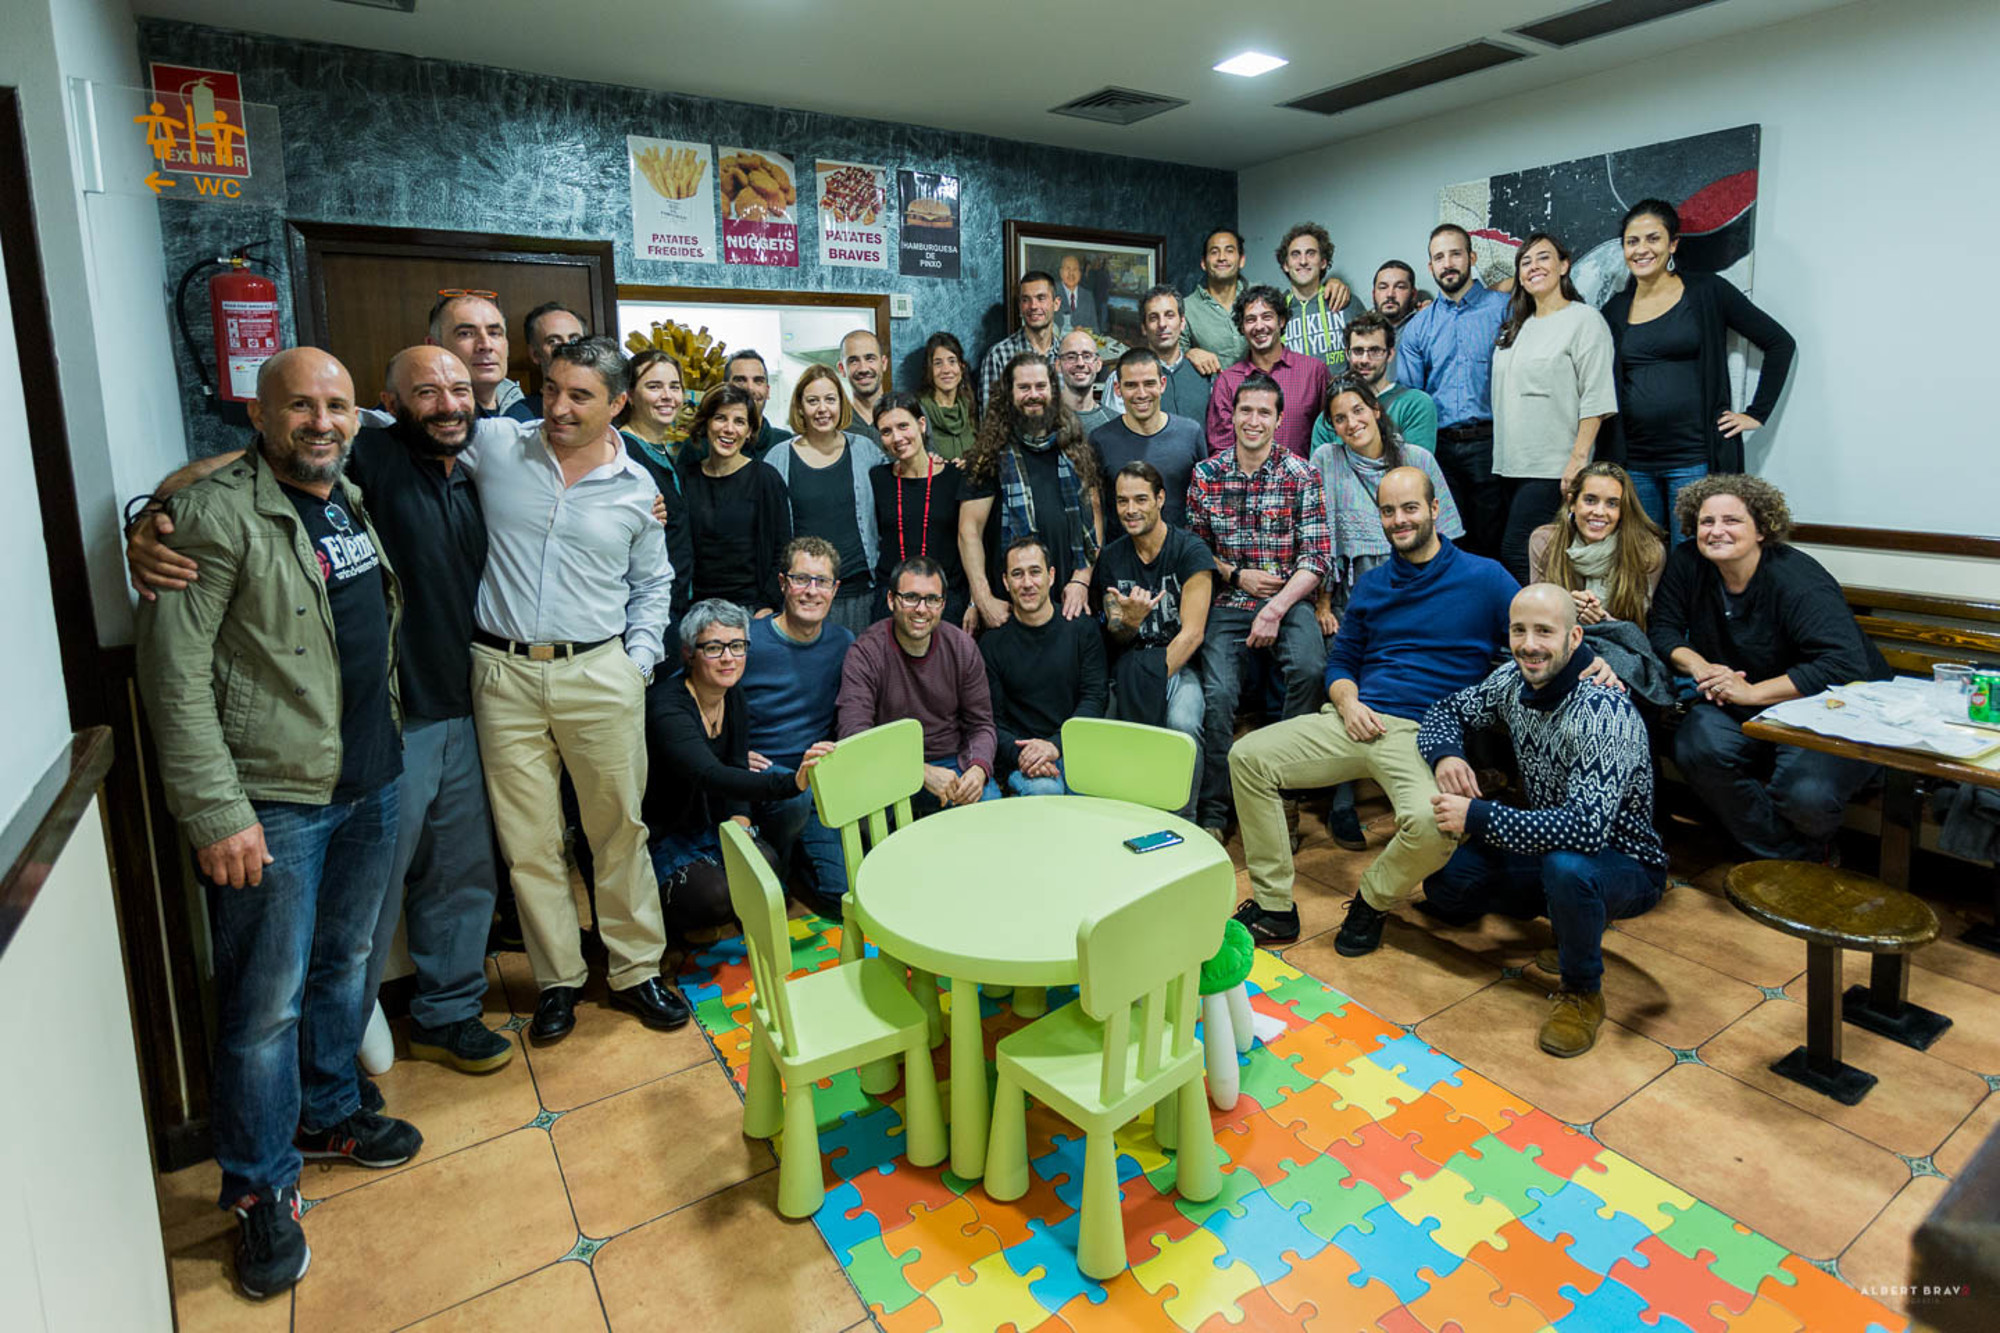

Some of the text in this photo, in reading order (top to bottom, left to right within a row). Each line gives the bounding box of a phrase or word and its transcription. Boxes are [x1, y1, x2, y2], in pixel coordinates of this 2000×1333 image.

[192, 176, 242, 198] WC
[652, 233, 699, 245] PATATES
[726, 234, 795, 251] NUGGETS
[825, 230, 882, 244] PATATES
[648, 245, 705, 258] FREGIDES
[903, 242, 958, 254] HAMBURGUESA
[829, 248, 880, 262] BRAVES
[926, 252, 936, 260] DE
[920, 260, 942, 268] PINXO
[1308, 331, 1346, 355] YORK
